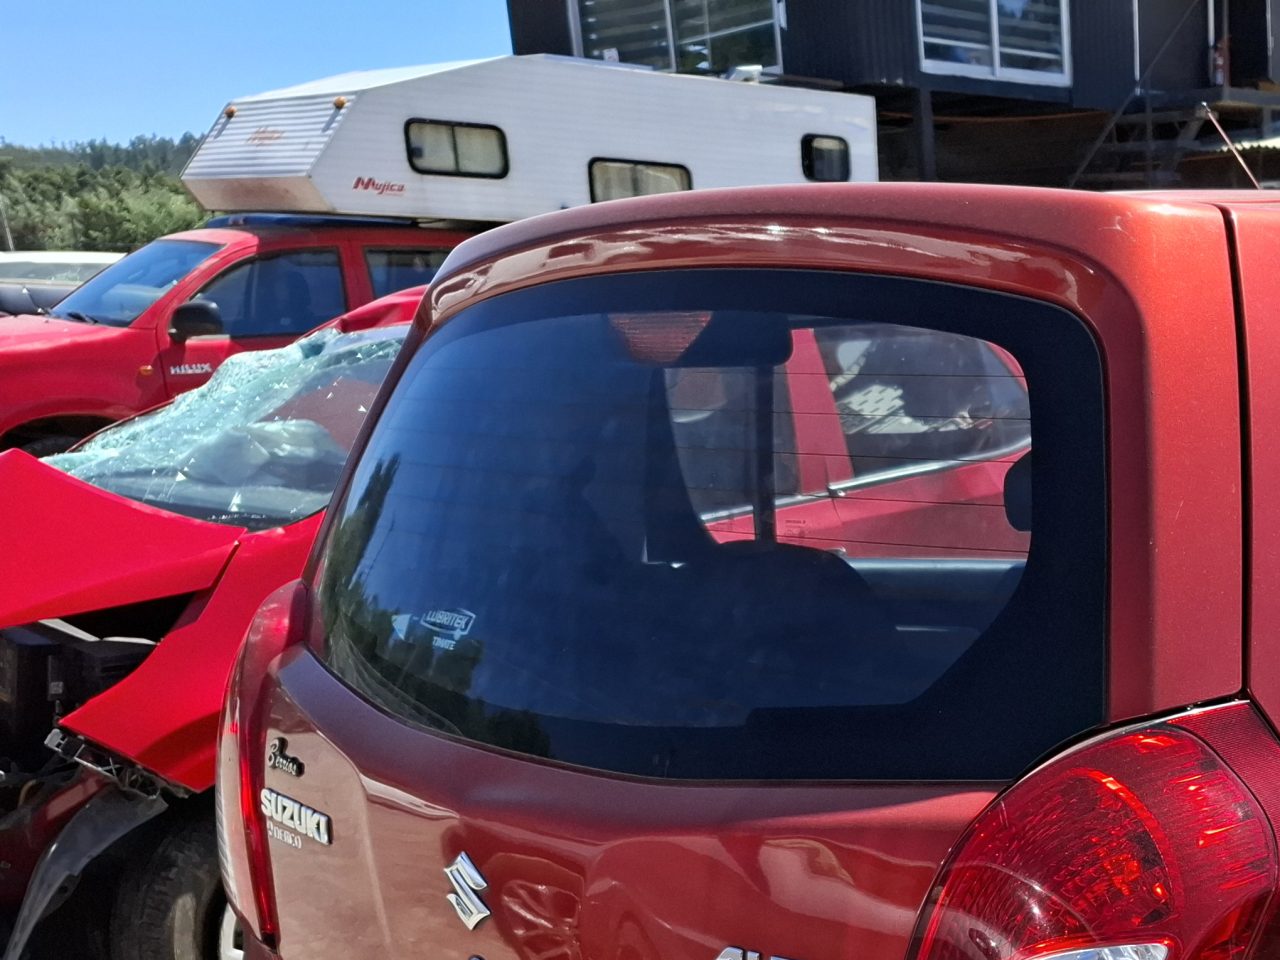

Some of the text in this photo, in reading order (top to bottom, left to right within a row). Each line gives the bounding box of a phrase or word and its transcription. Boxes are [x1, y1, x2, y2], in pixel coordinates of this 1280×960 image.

[352, 176, 405, 195] Mujica
[170, 362, 212, 375] HILUX
[426, 610, 470, 629] LUBRITEK
[260, 787, 331, 846] SUZUKI
